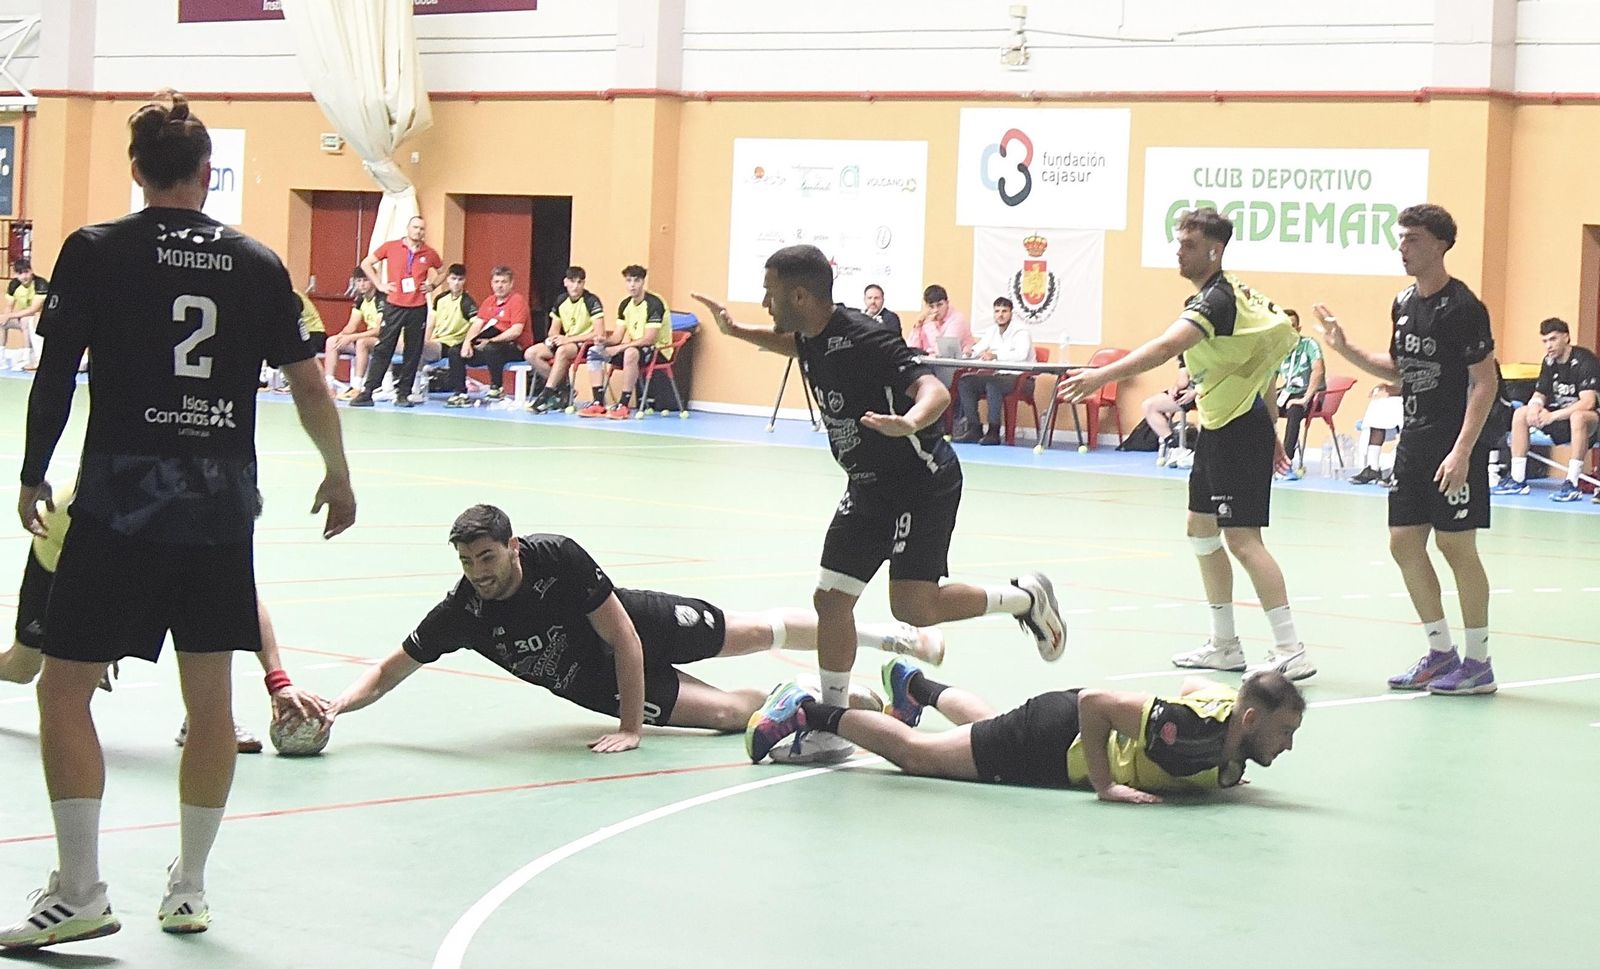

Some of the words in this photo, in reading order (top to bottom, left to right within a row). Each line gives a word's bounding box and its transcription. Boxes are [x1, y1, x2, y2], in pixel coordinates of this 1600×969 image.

[1043, 151, 1106, 167] fundación
[1041, 167, 1092, 186] cajasur
[1193, 167, 1243, 188] CLUB
[1252, 168, 1373, 191] DEPORTIVO
[157, 247, 233, 271] MORENO
[172, 294, 218, 379] 2
[182, 394, 209, 412] Islas
[144, 408, 210, 426] Canarias
[514, 635, 543, 653] 30
